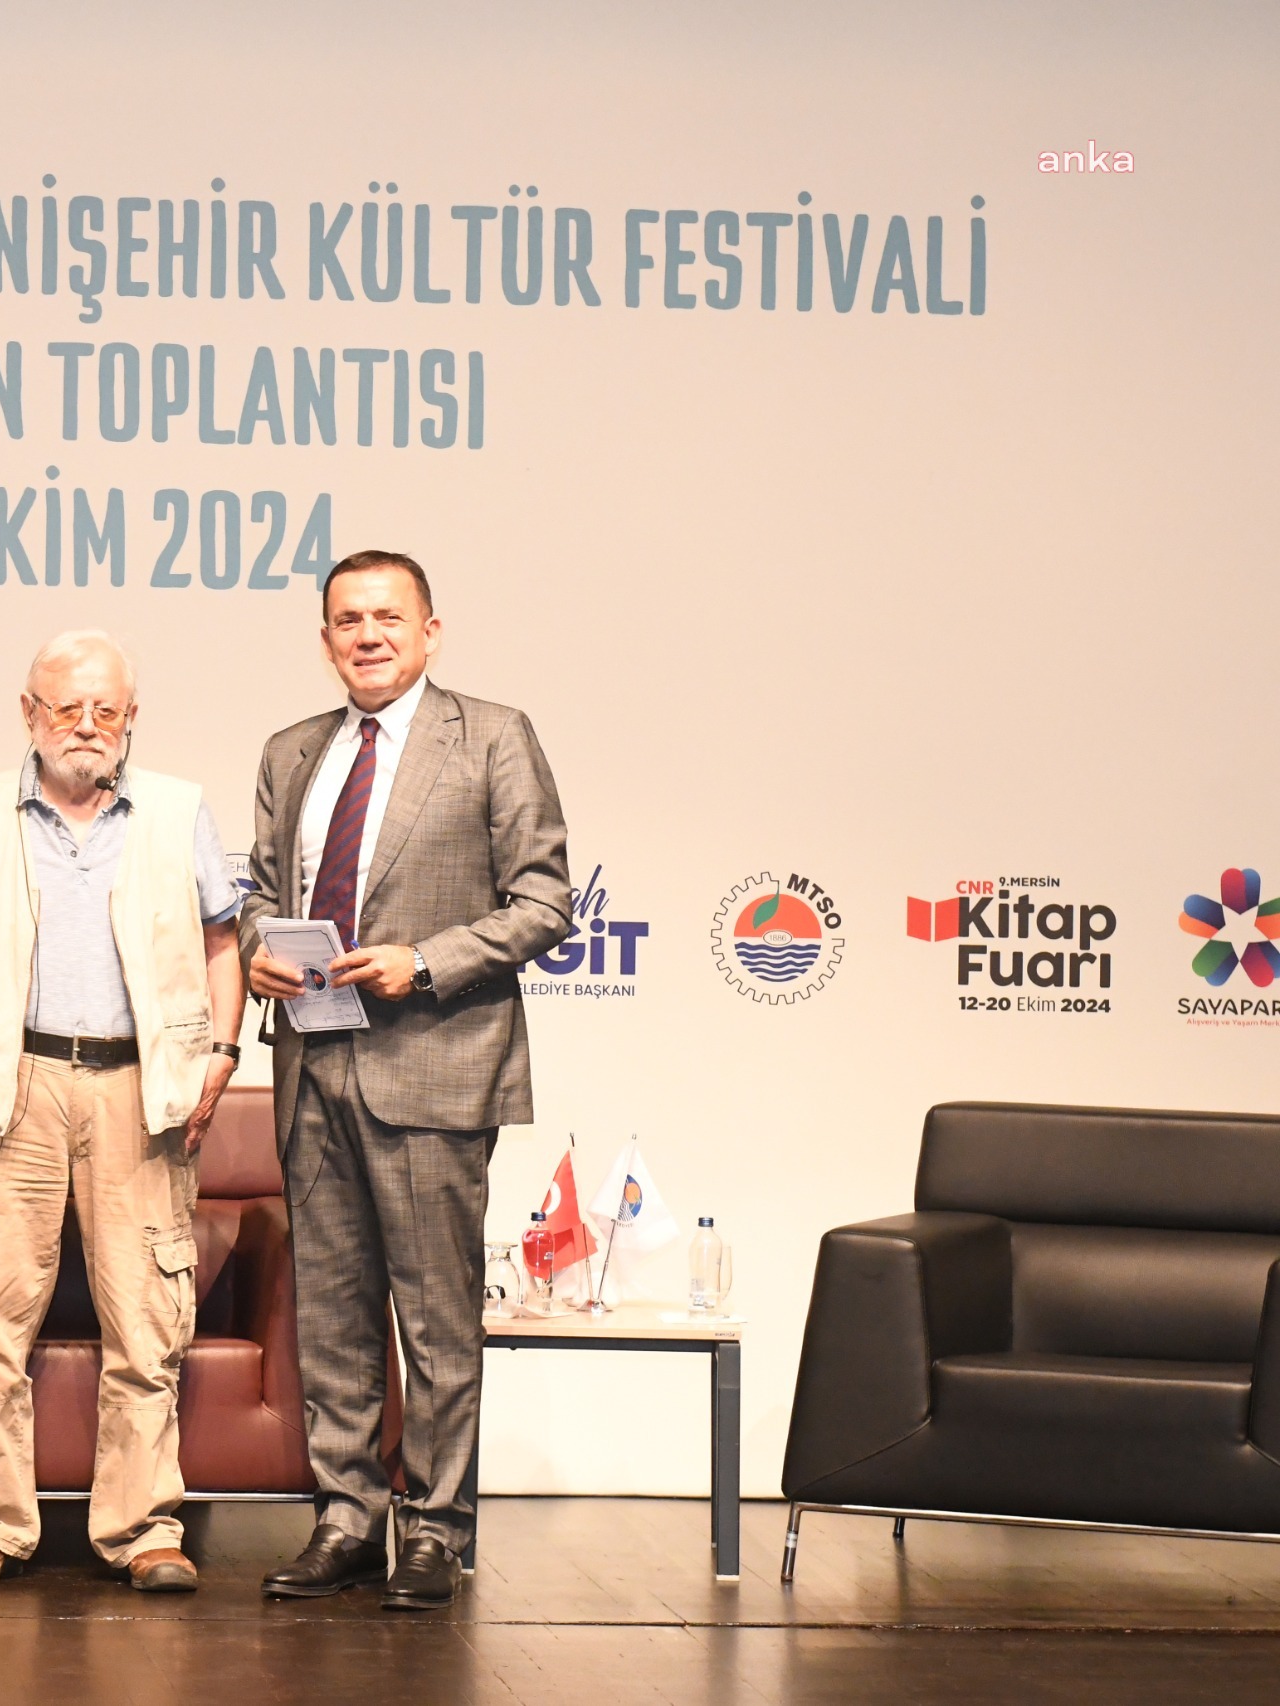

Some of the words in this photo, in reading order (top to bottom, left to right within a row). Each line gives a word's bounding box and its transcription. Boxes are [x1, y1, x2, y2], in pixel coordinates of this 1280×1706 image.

[308, 181, 602, 308] KÜLTÜR
[625, 191, 987, 317] FESTİVALİ
[47, 341, 485, 450] TOPLANTISI
[150, 488, 338, 592] 2024
[786, 873, 842, 930] MTSO
[956, 880, 994, 895] CNR
[958, 889, 1117, 951] Kitap
[574, 984, 635, 999] BAŞKANI
[958, 944, 1111, 988] Fuarı
[958, 996, 1011, 1011] 12-20
[1017, 996, 1056, 1012] Ekim
[1061, 998, 1111, 1013] 2024
